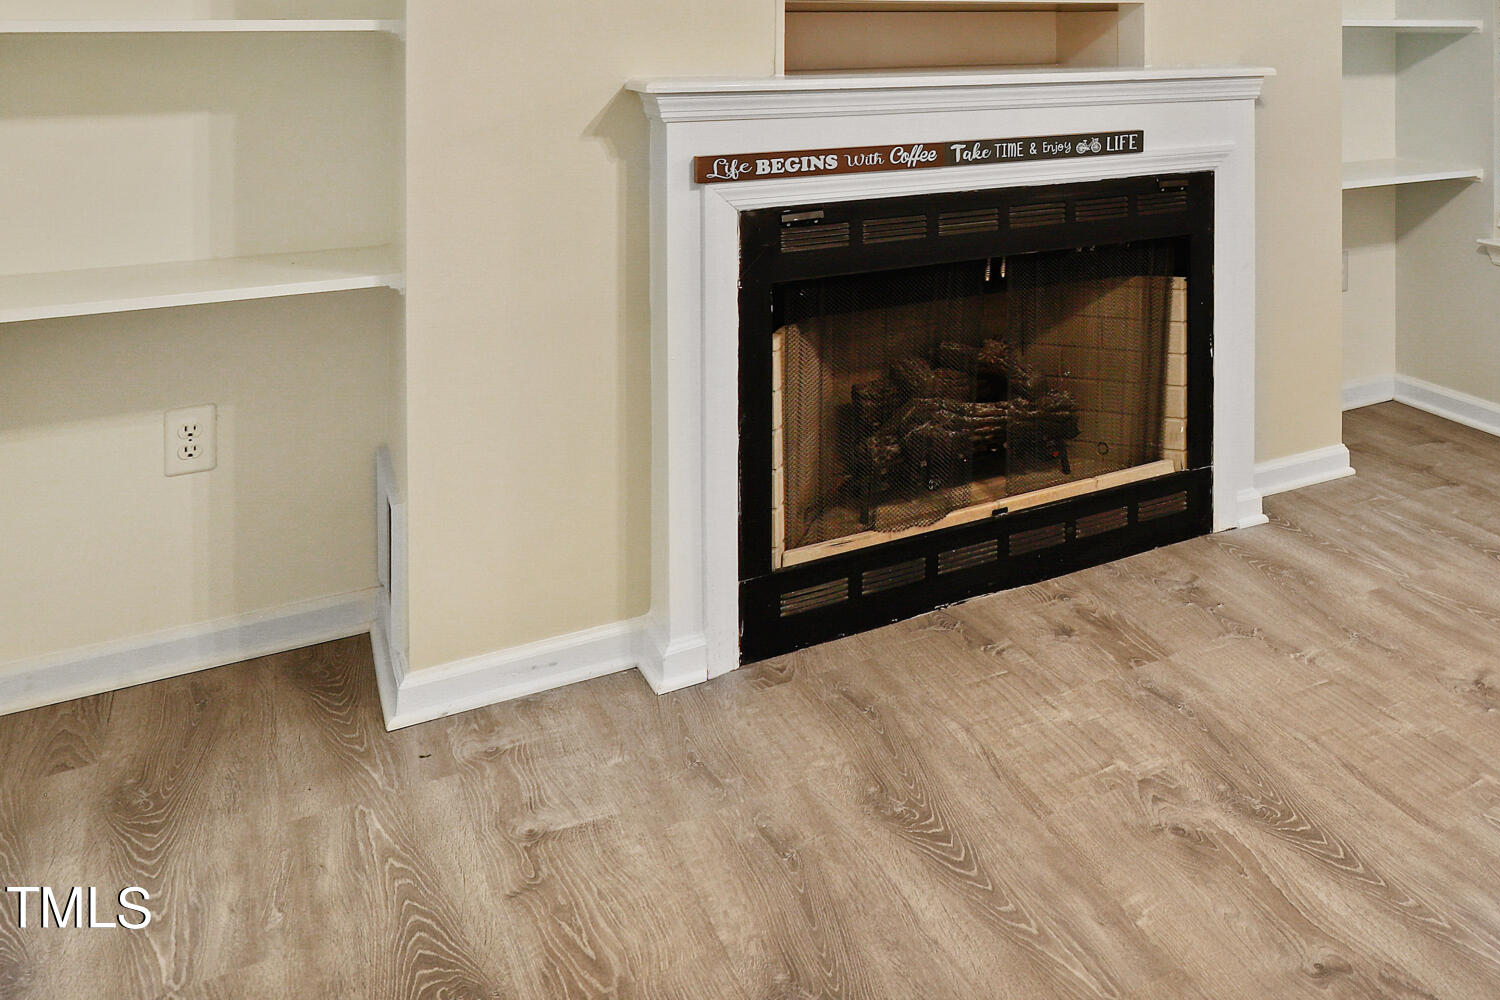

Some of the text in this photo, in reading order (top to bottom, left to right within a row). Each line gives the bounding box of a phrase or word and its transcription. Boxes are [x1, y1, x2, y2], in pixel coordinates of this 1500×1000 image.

[706, 134, 1138, 179] Life BEGINS With Coffee Take TIME & Enjoy LIFE
